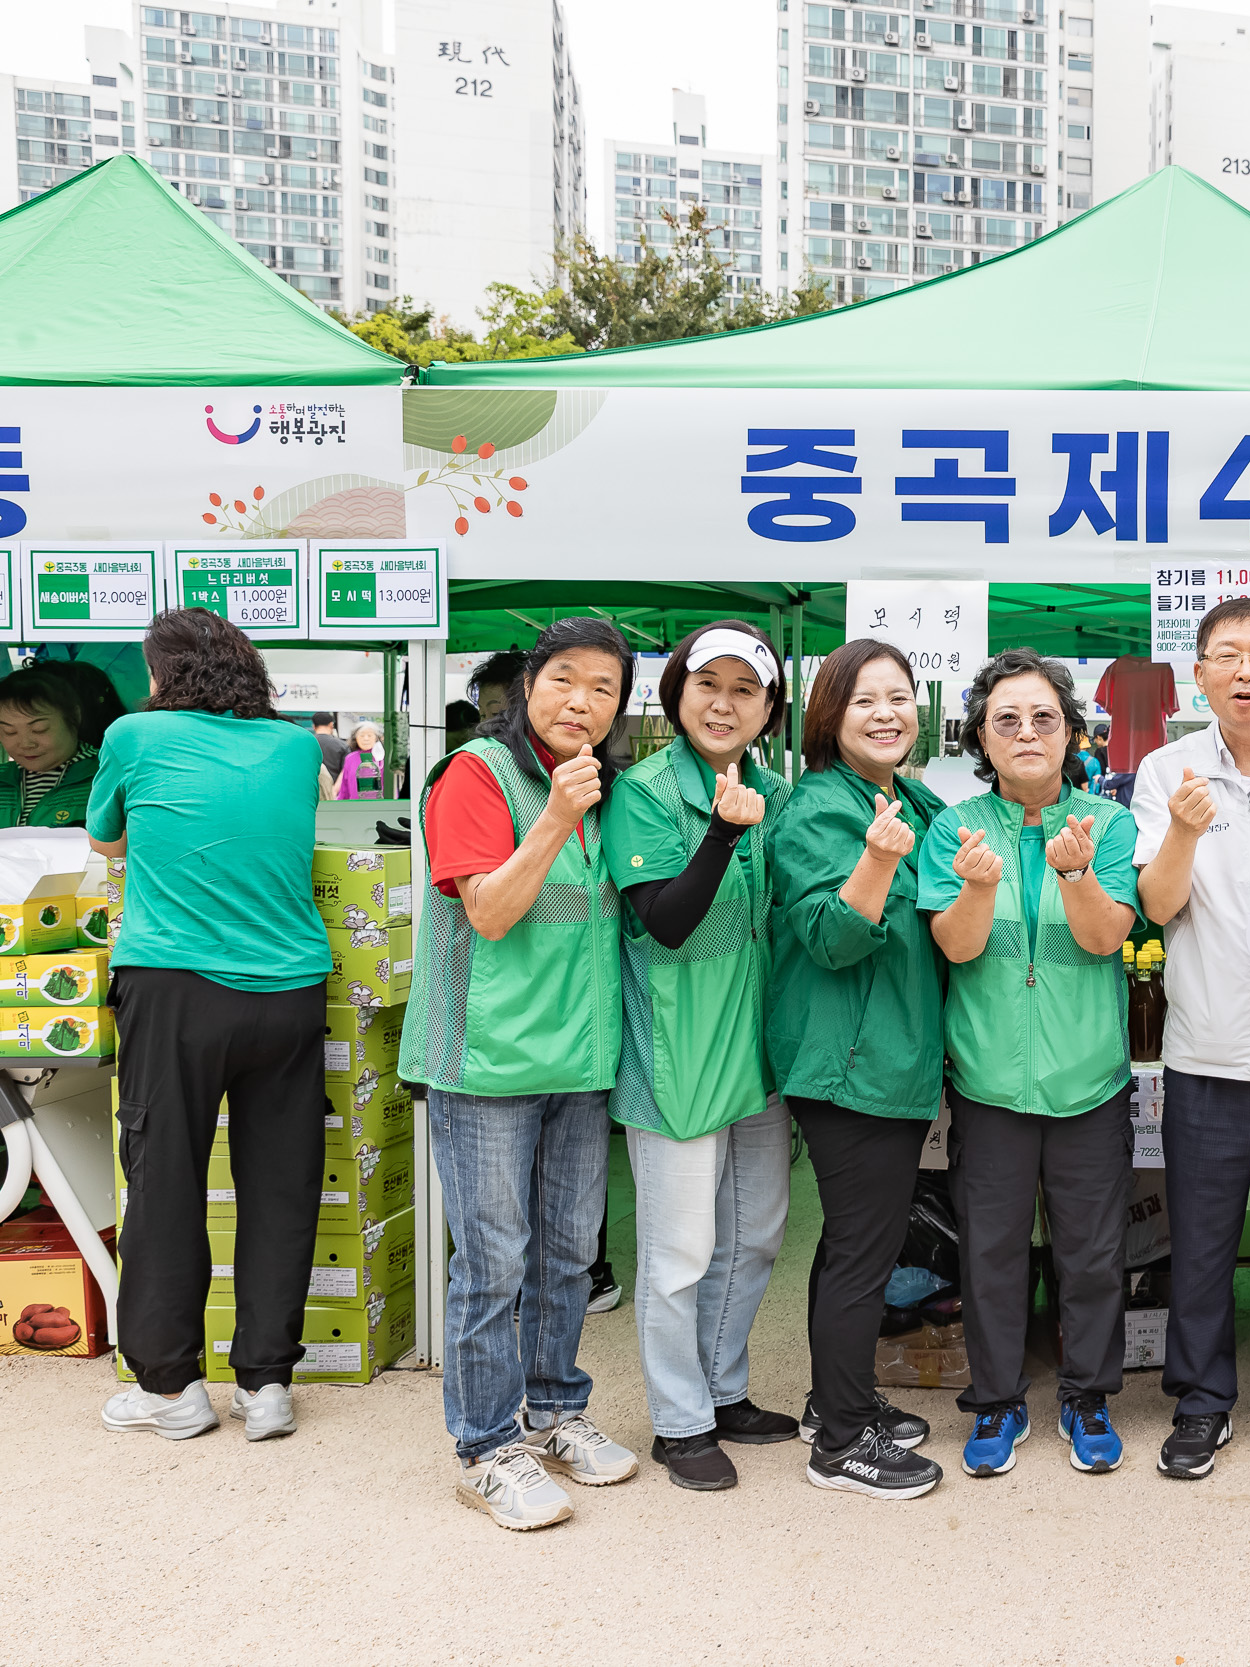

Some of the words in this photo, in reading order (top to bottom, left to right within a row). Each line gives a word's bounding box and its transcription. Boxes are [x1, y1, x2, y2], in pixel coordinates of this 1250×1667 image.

[438, 41, 510, 66] 現代
[456, 77, 493, 97] 212
[1222, 157, 1250, 175] 213
[269, 402, 305, 420] 소통하며
[307, 403, 346, 420] 발전하는
[269, 417, 346, 445] 행복광진
[56, 562, 87, 573] 중곡3동
[93, 562, 142, 573] 새마을부녀회
[200, 557, 231, 568] 중곡3동
[237, 557, 286, 568] 새마을부녀회
[344, 560, 374, 571] 중곡3동
[380, 560, 427, 571] 새마을부녀회
[1156, 569, 1206, 586] 참기름
[40, 591, 89, 604] 새송이버섯
[92, 590, 147, 606] 12,000원
[233, 589, 287, 604] 11,000원
[379, 588, 431, 604] 13,000원
[1156, 595, 1206, 612] 들기름
[241, 607, 287, 622] 6,000원
[1156, 618, 1191, 629] 계좌이체
[842, 1459, 880, 1481] HOKA
